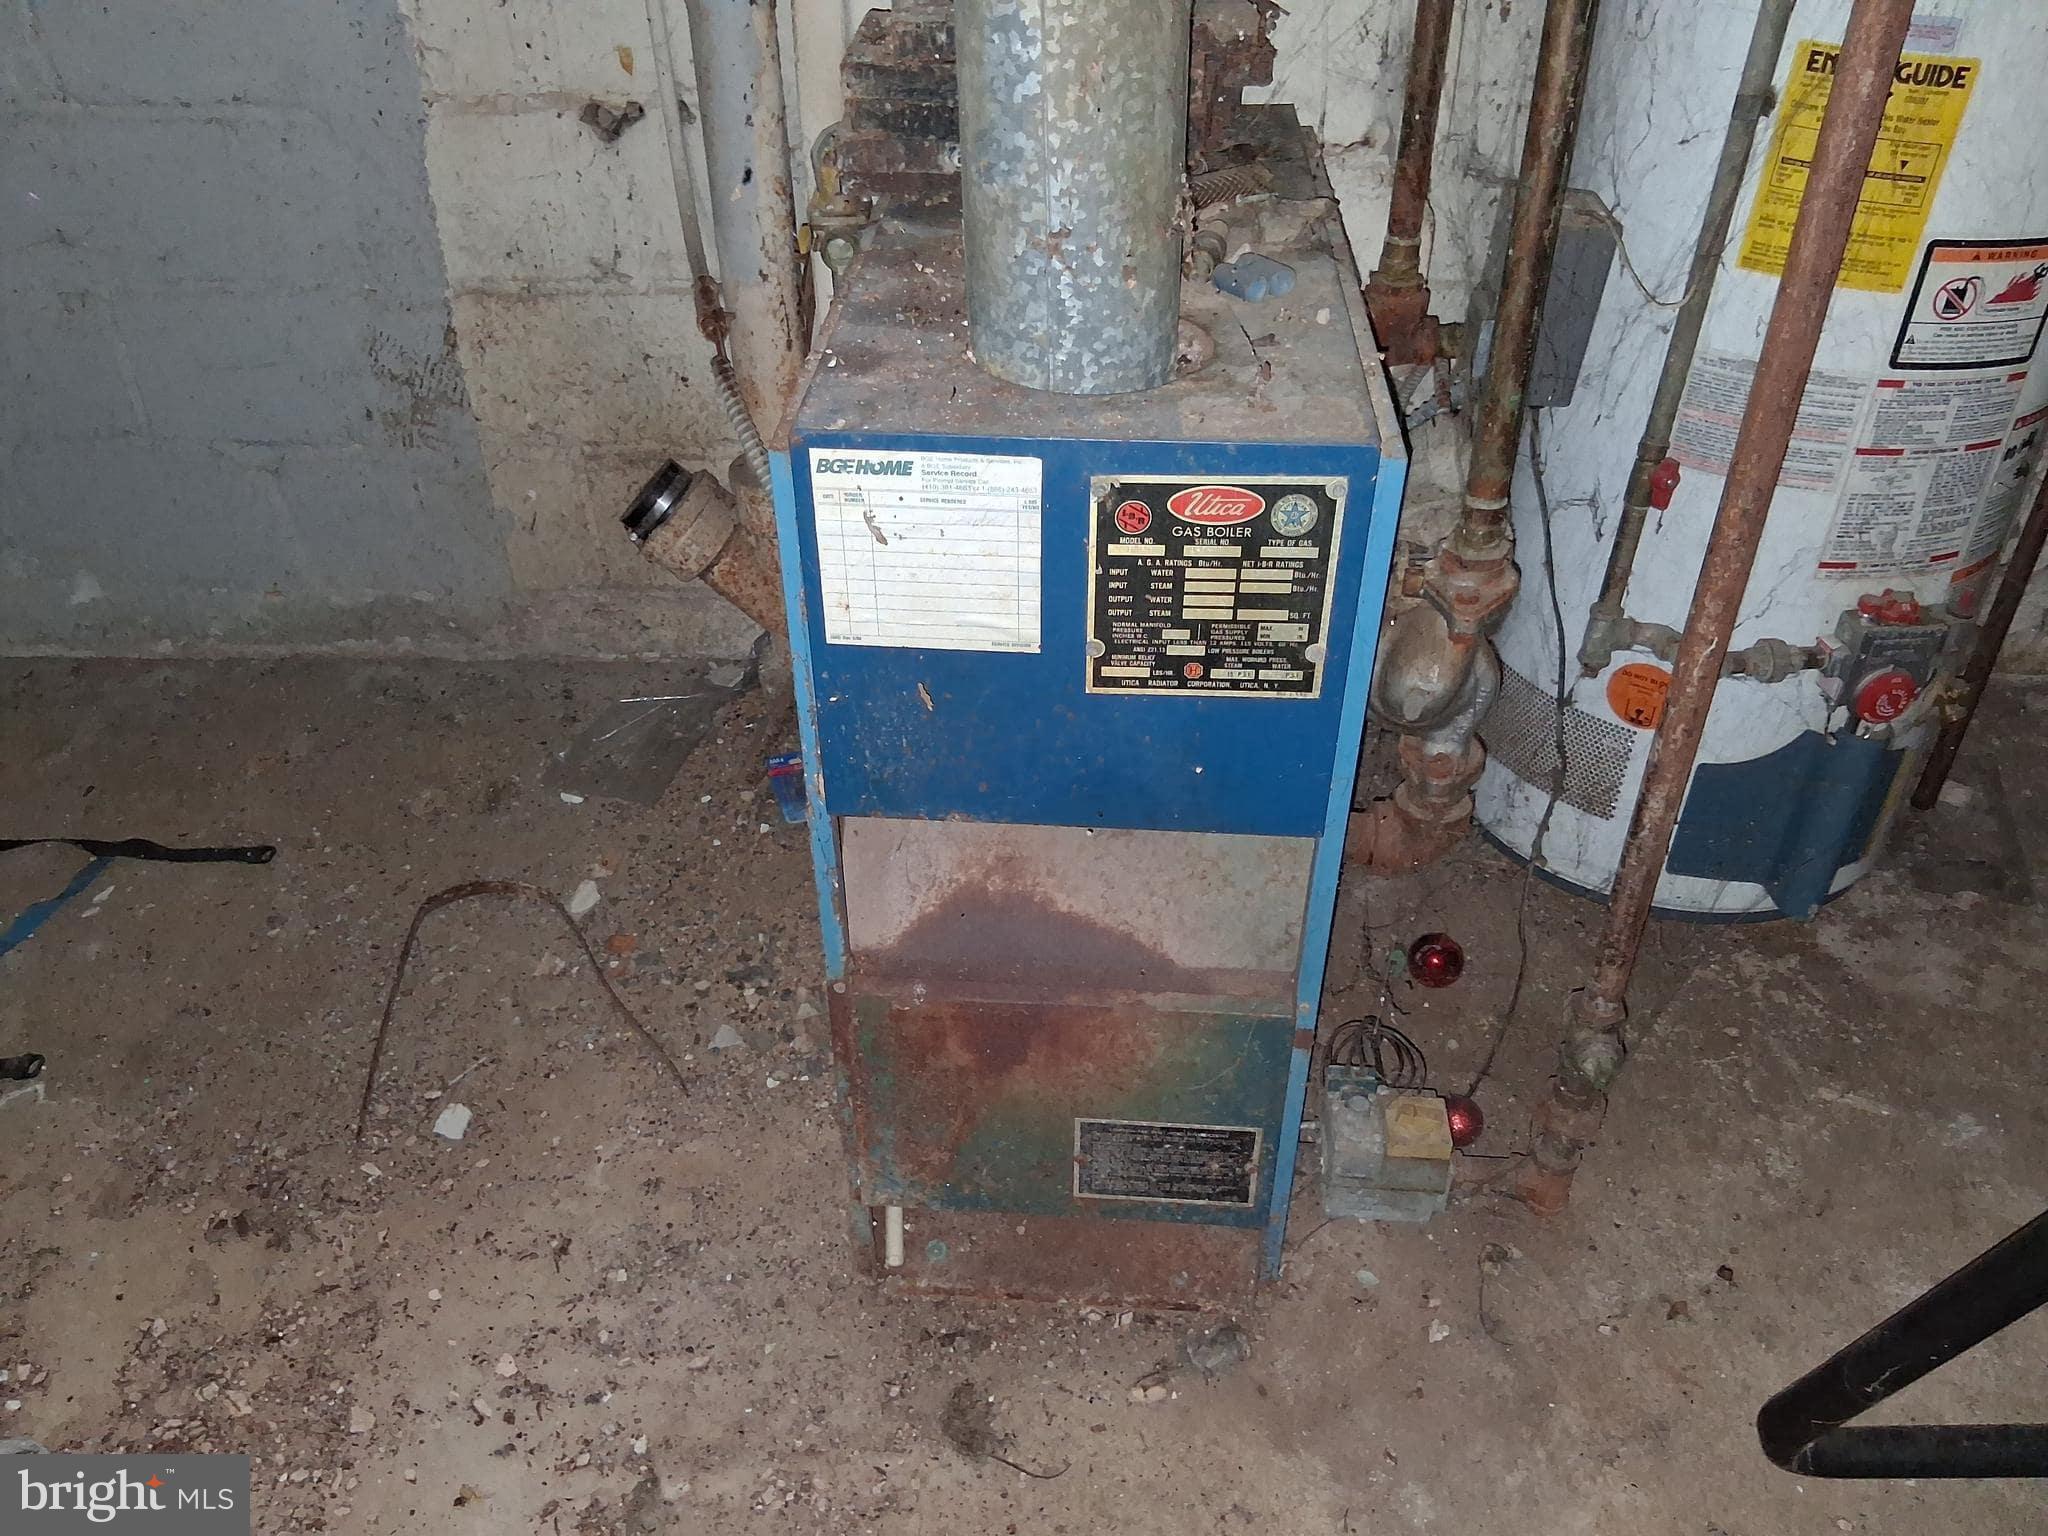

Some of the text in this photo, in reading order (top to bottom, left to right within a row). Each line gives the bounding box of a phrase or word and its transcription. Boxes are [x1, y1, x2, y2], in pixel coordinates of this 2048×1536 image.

[1894, 62, 1971, 89] GUIDE
[1988, 249, 2039, 260] WARNING
[855, 459, 914, 476] HOME
[1184, 491, 1252, 517] Utica
[1172, 526, 1252, 538] GAS BOILER
[1195, 538, 1217, 546] SERIAL
[1109, 568, 1174, 577] INPUT WATER
[1108, 581, 1173, 590] INPUT STEAM
[1108, 595, 1172, 604] OUTPUT WATER
[1149, 609, 1171, 617] STEAM
